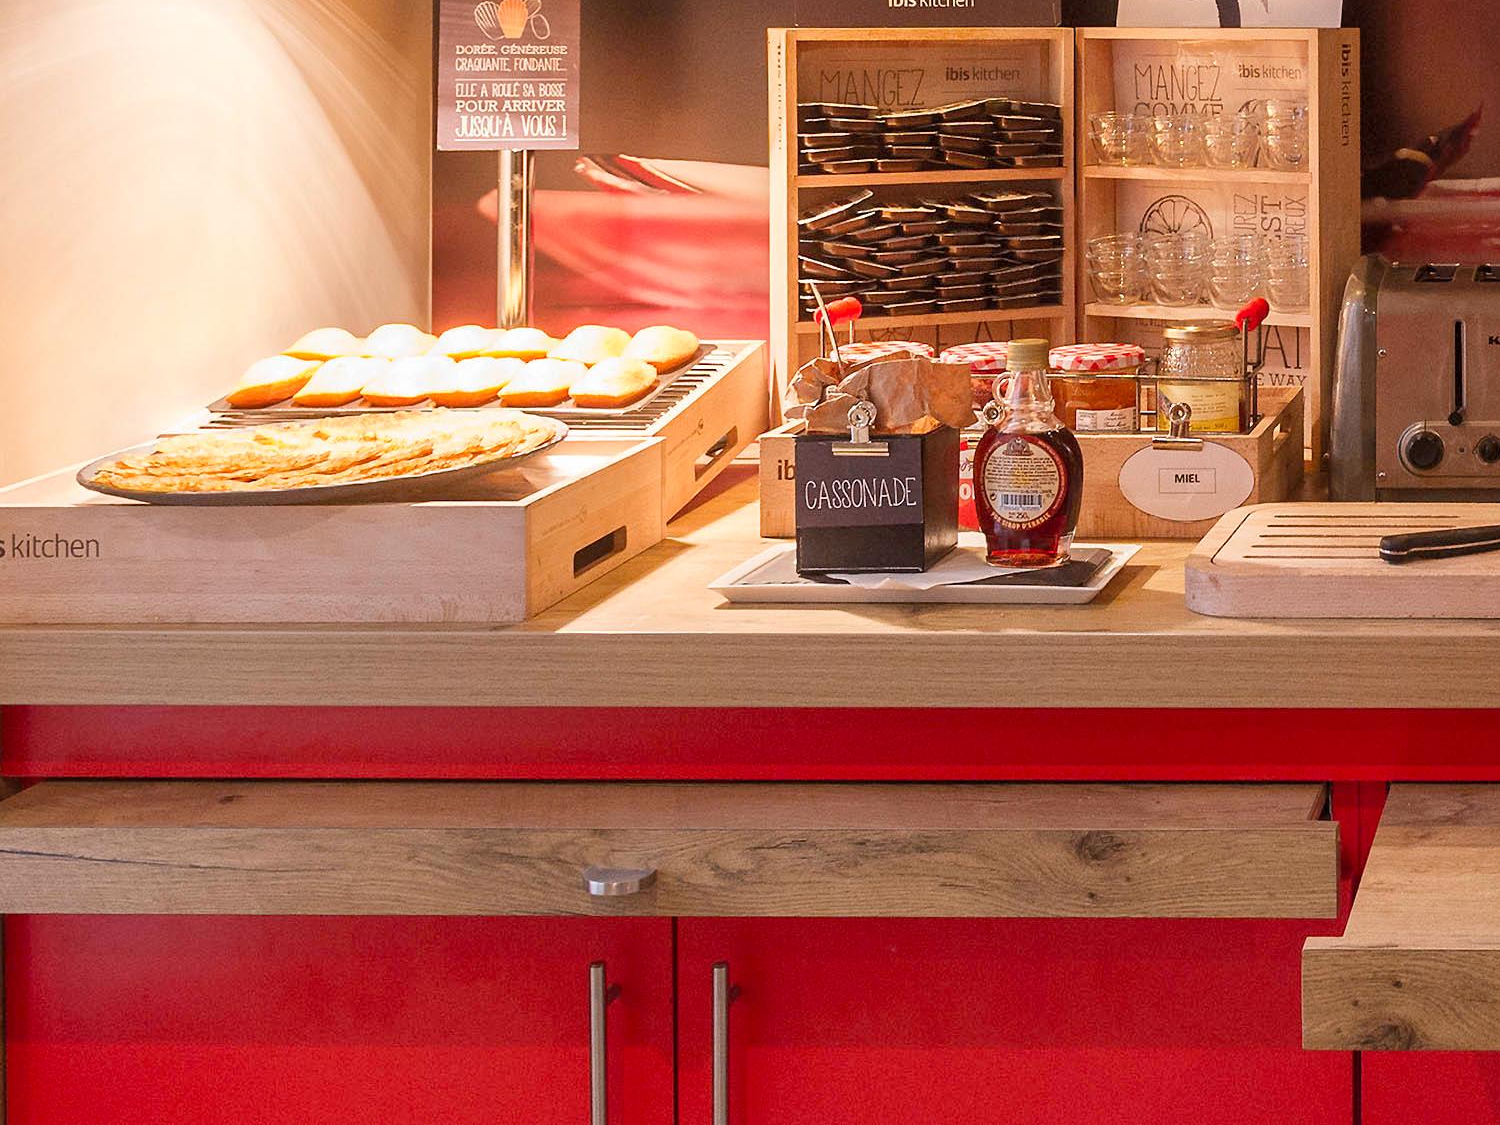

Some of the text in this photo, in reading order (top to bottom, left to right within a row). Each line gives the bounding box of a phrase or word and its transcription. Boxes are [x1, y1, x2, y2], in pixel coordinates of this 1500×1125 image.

[500, 43, 568, 55] GÉNÉREUSE
[945, 66, 1020, 81] ibis kitchen
[1238, 63, 1302, 80] ibis kitchen
[456, 81, 566, 98] ELLE A ROULÉ SA BOSSE
[818, 68, 925, 107] MANGEZ
[1134, 63, 1223, 101] MANGEZ
[1340, 43, 1353, 148] ibis kitchen
[455, 100, 566, 113] POUR ARRIVER
[455, 113, 514, 138] JUSQU'À
[521, 115, 556, 137] VOUS
[1269, 373, 1307, 386] WAY
[777, 459, 796, 481] ib
[1174, 473, 1200, 484] MIEL
[805, 477, 917, 510] CASSONADE
[12, 533, 100, 558] kitchen
